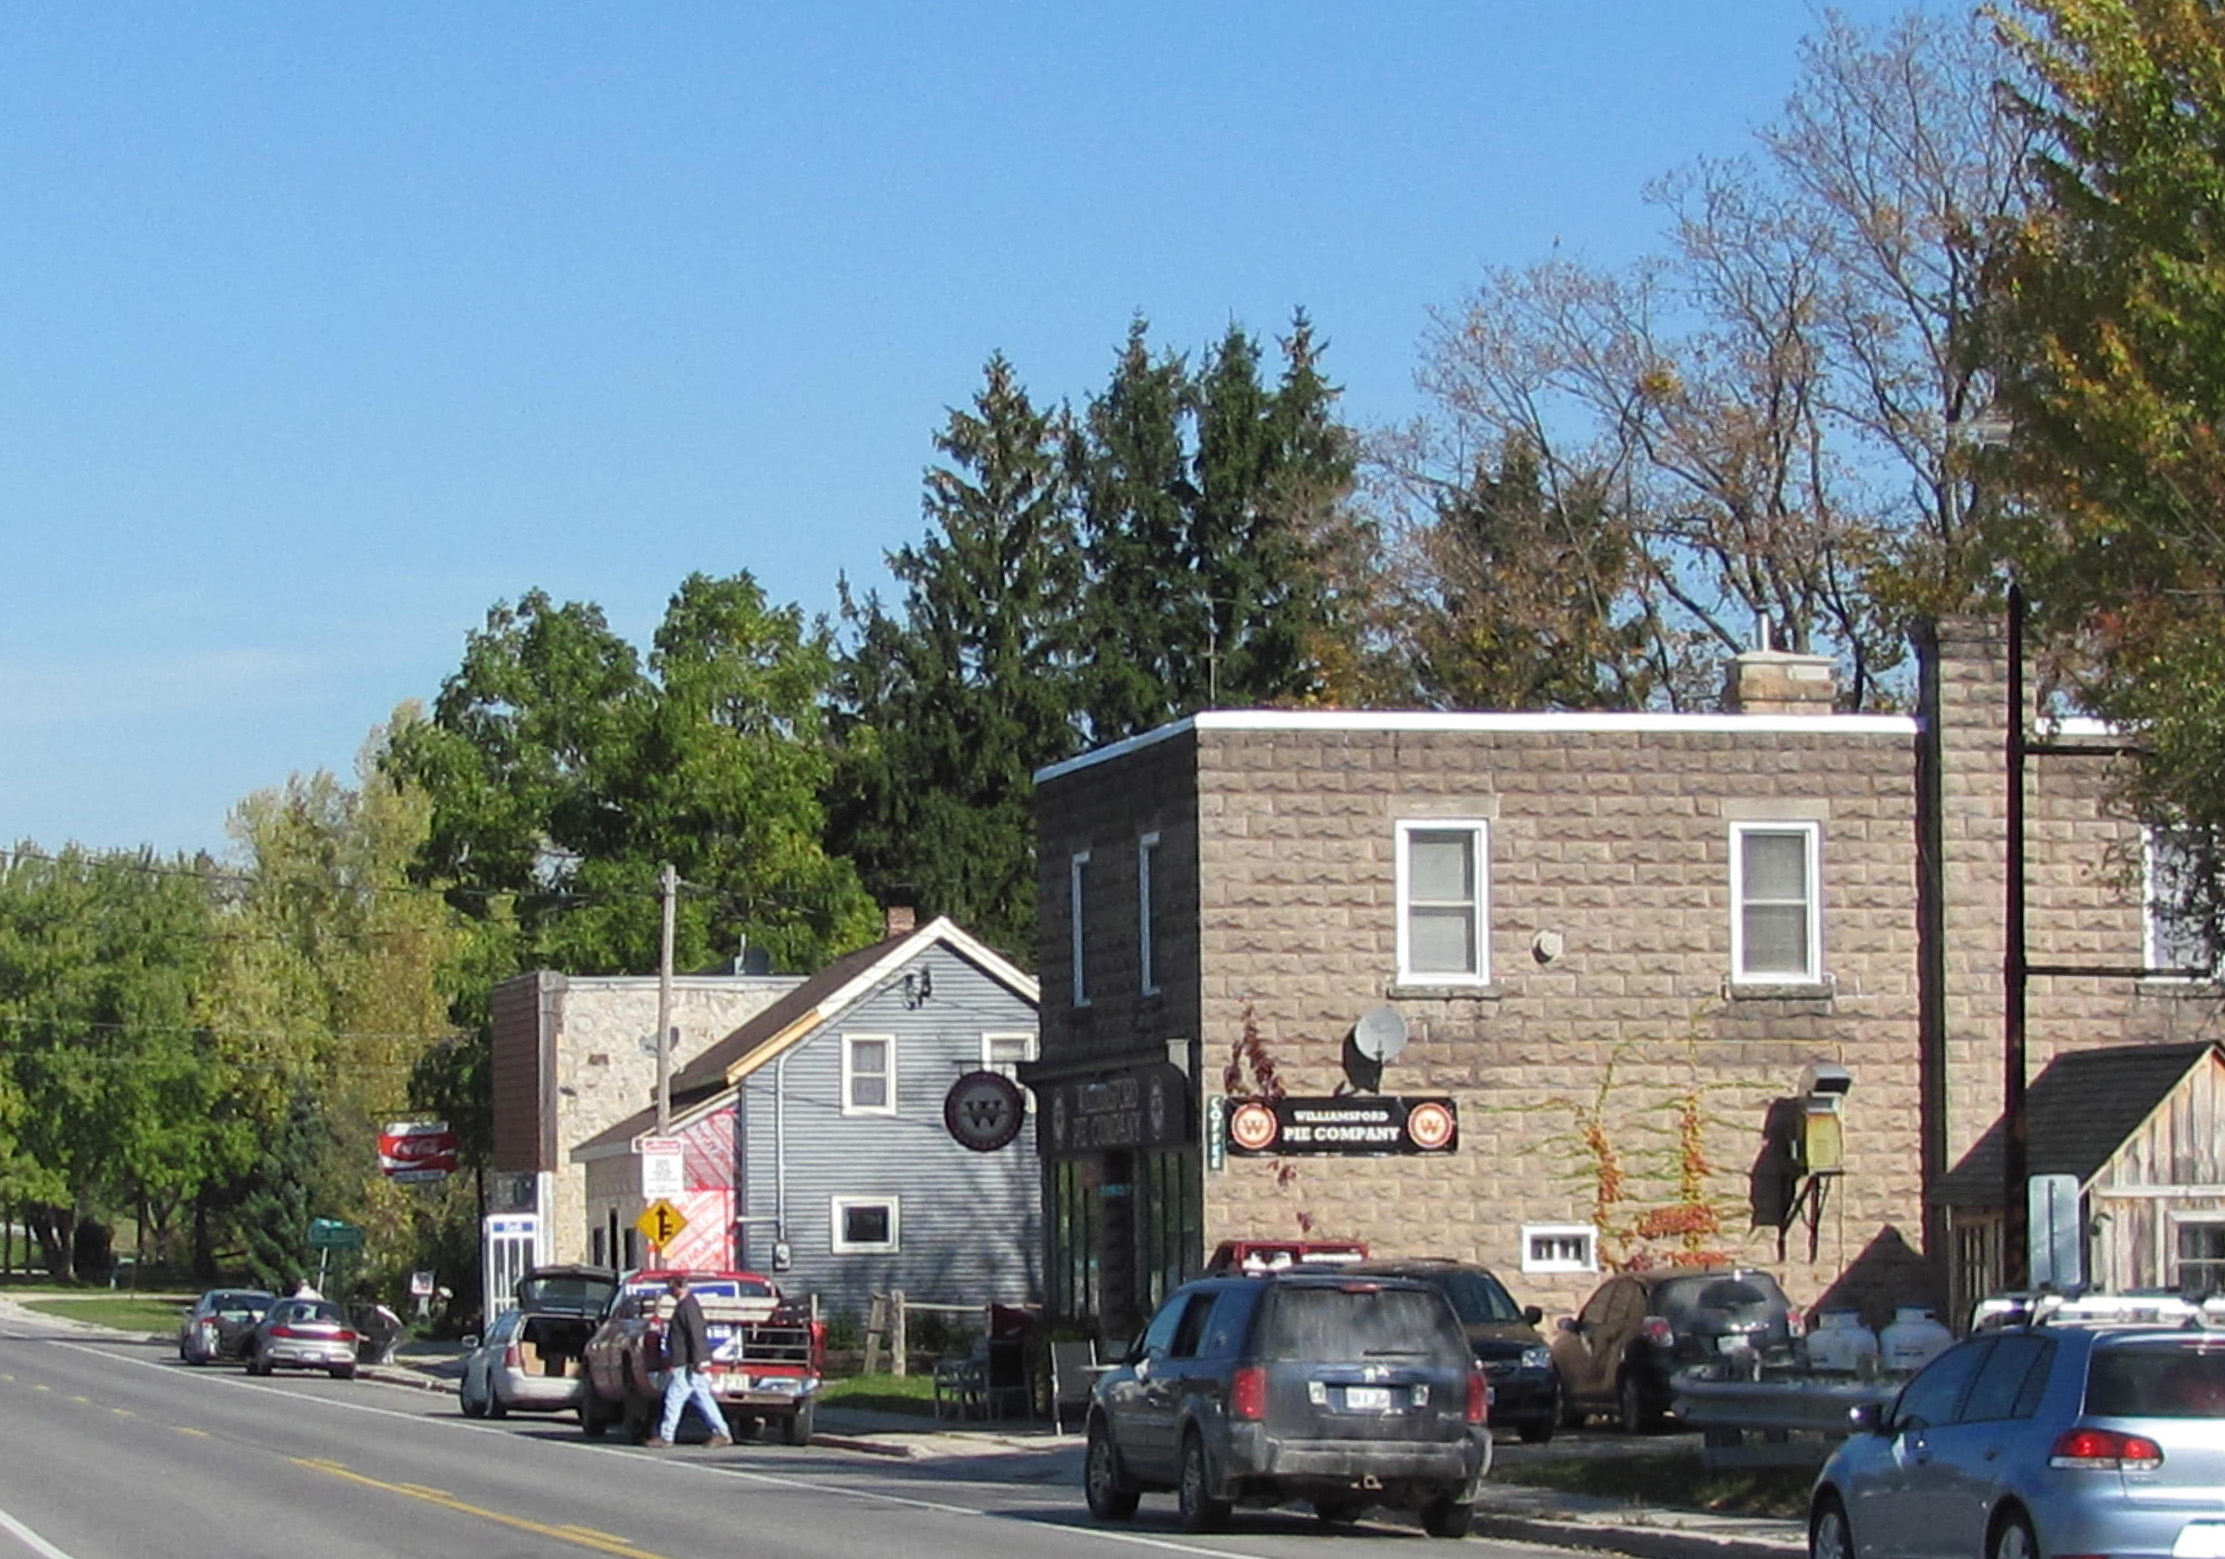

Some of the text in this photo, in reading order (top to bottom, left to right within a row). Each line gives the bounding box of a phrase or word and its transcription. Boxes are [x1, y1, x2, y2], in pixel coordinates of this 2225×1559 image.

[964, 1100, 1002, 1128] W
[1293, 1110, 1389, 1122] WILLIAMSFORD
[1282, 1126, 1400, 1141] PIE COMPANY
